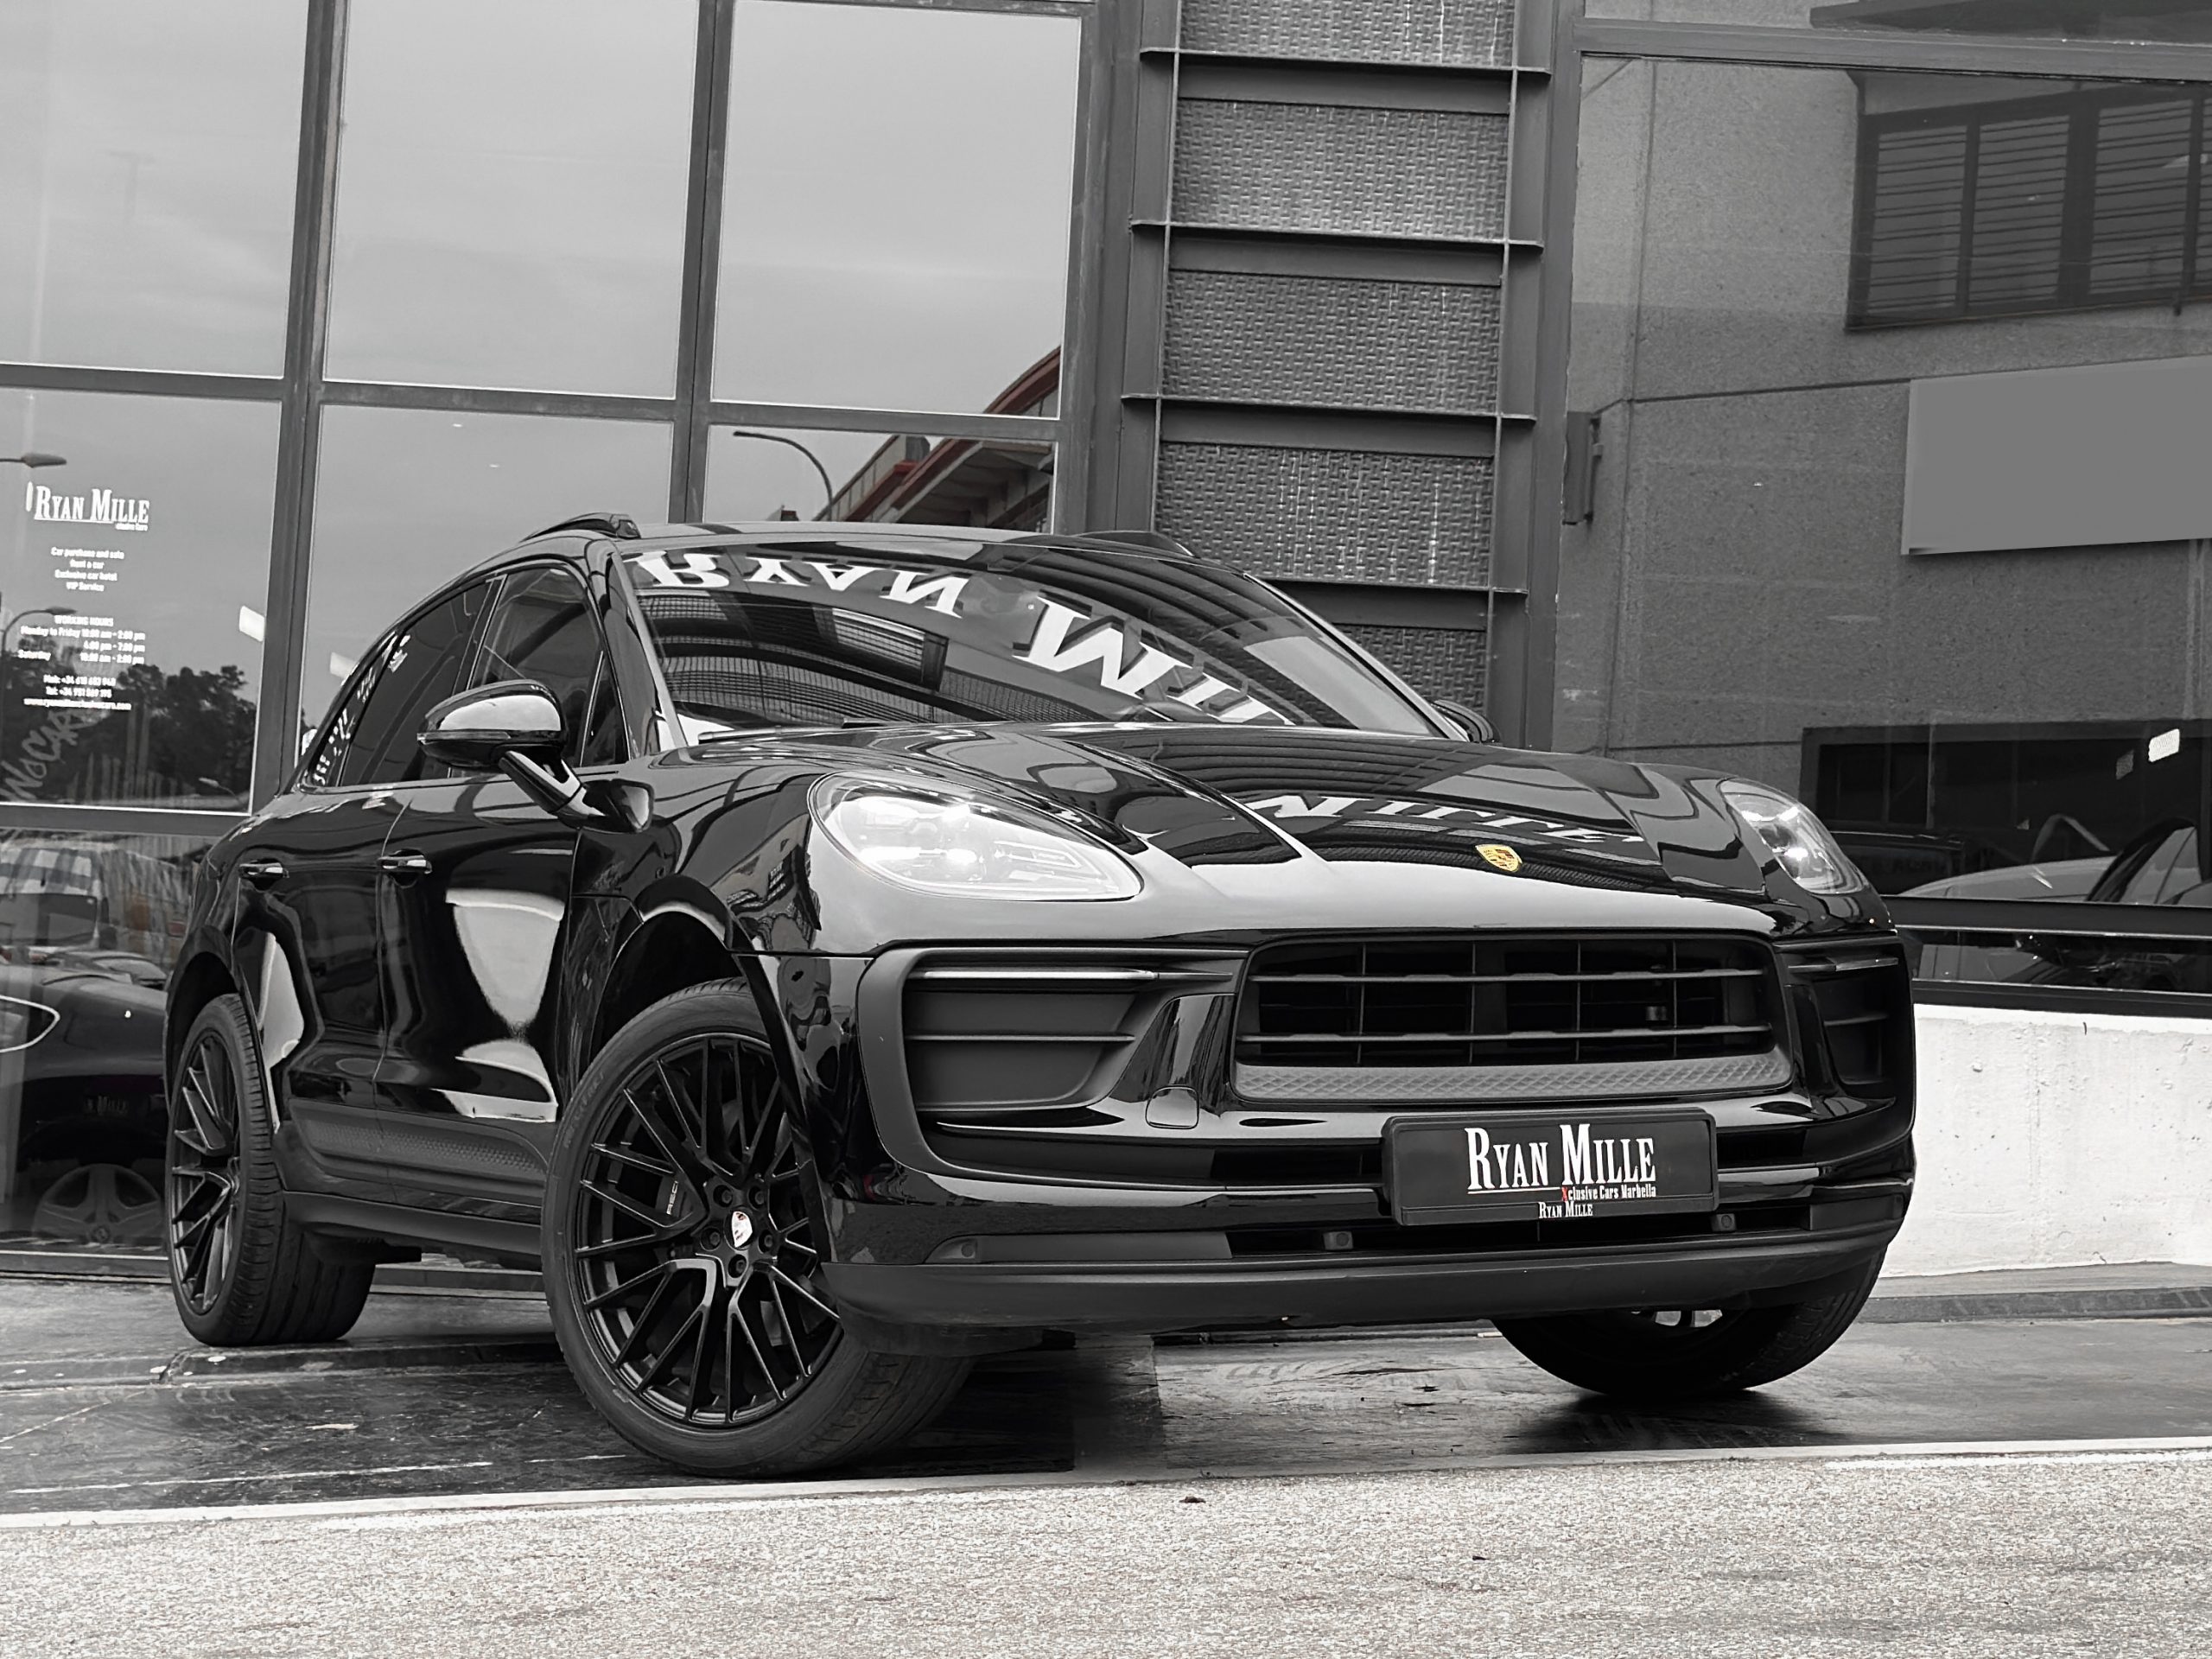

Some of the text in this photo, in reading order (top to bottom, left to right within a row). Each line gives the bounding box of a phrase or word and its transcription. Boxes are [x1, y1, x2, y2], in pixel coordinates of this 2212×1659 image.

[34, 486, 150, 524] RYAN MILLE
[1465, 1123, 1656, 1191] RYAN MILLE
[1561, 1184, 1656, 1202] Xclusive Cars Marbella
[1538, 1200, 1593, 1219] RYAN MILLE
